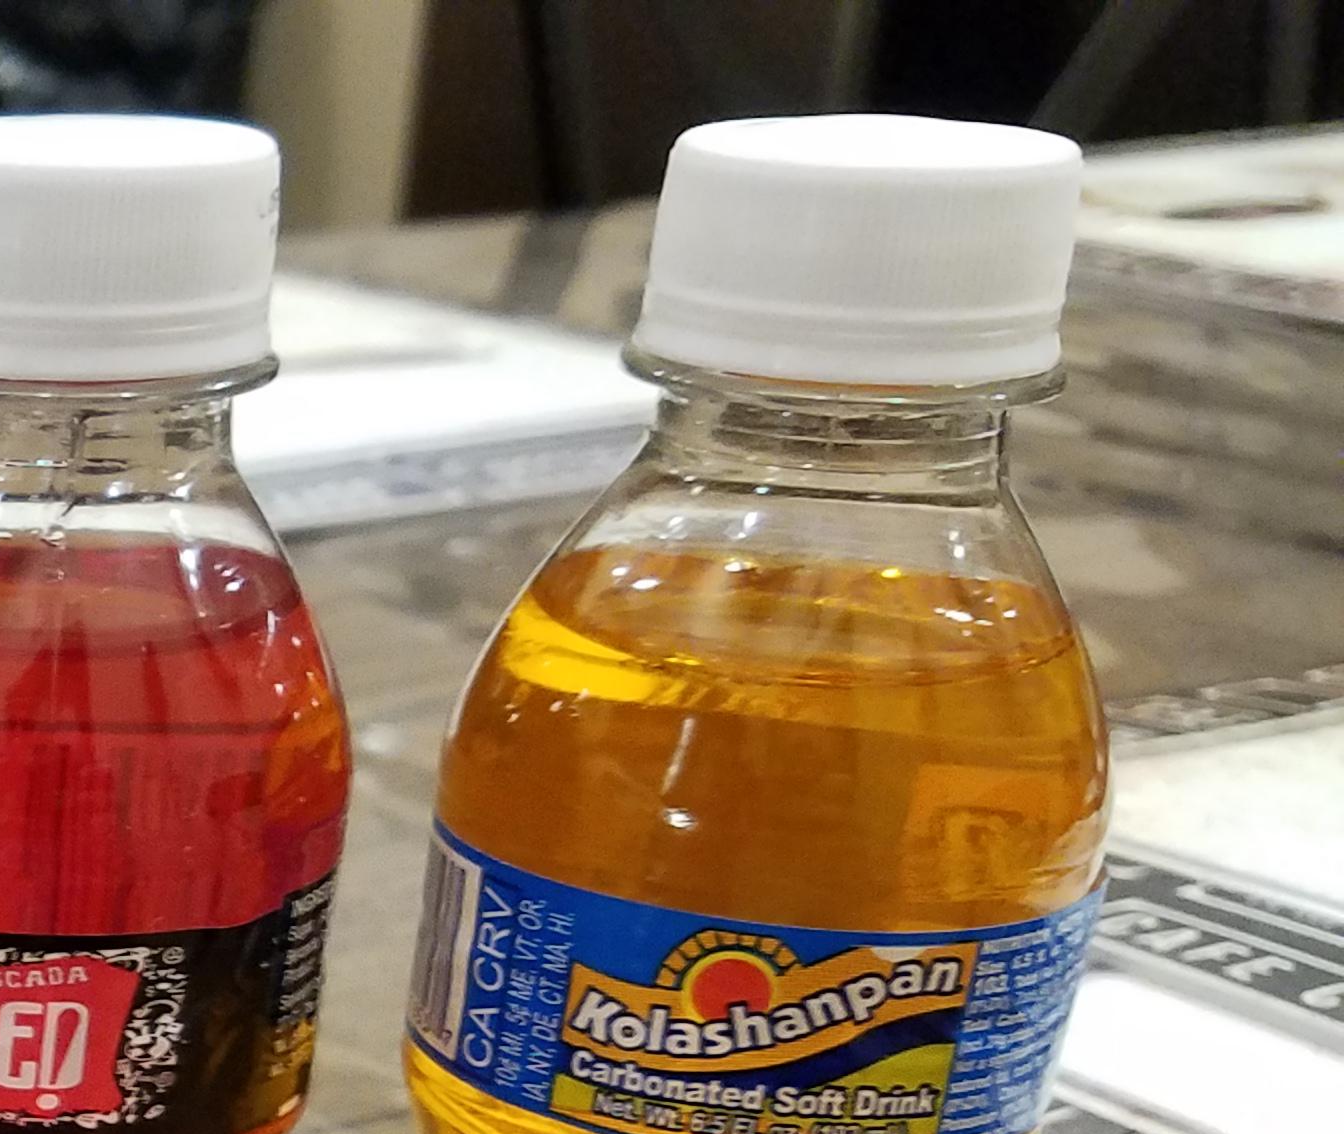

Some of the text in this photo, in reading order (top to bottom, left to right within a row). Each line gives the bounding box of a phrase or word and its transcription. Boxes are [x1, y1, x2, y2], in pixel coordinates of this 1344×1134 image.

[462, 885, 515, 1069] CA CRV
[571, 955, 962, 1057] Kolashanpan
[569, 1049, 939, 1118] Carbonated Soft Drink
